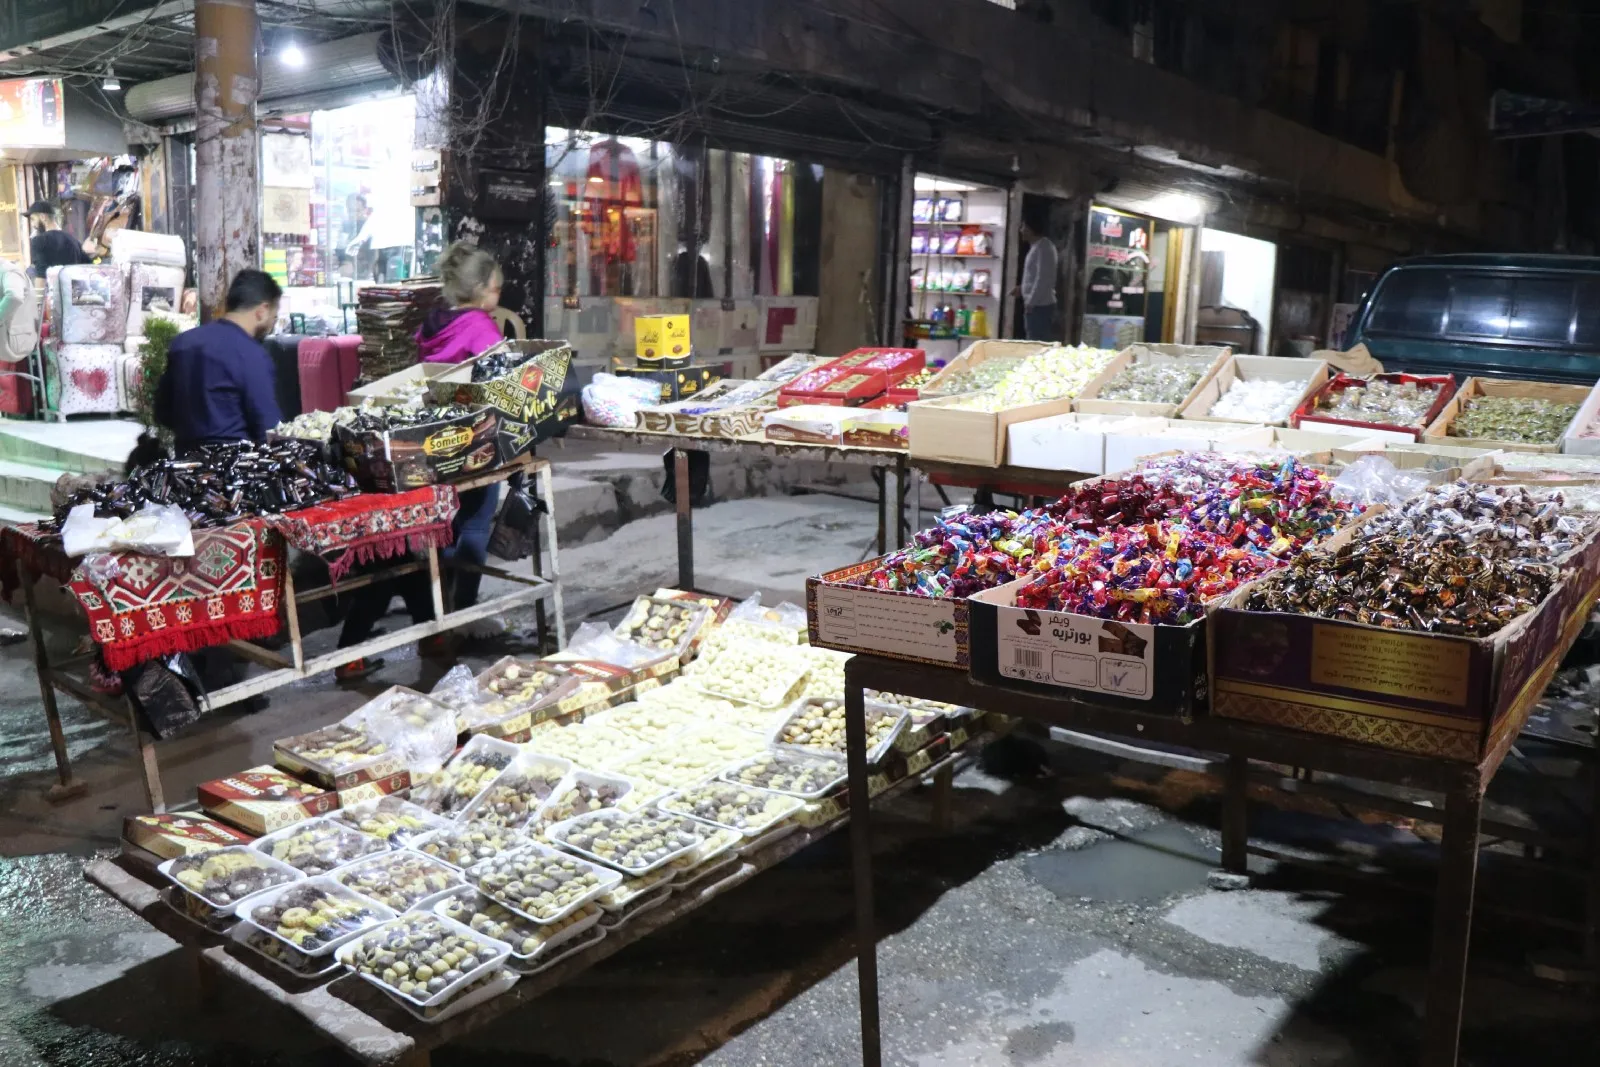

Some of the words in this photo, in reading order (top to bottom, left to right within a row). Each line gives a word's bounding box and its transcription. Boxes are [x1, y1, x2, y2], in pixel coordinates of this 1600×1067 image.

[429, 432, 470, 450] Sometra
[1048, 613, 1070, 628] ويفر
[1052, 628, 1092, 645] بورتريه
